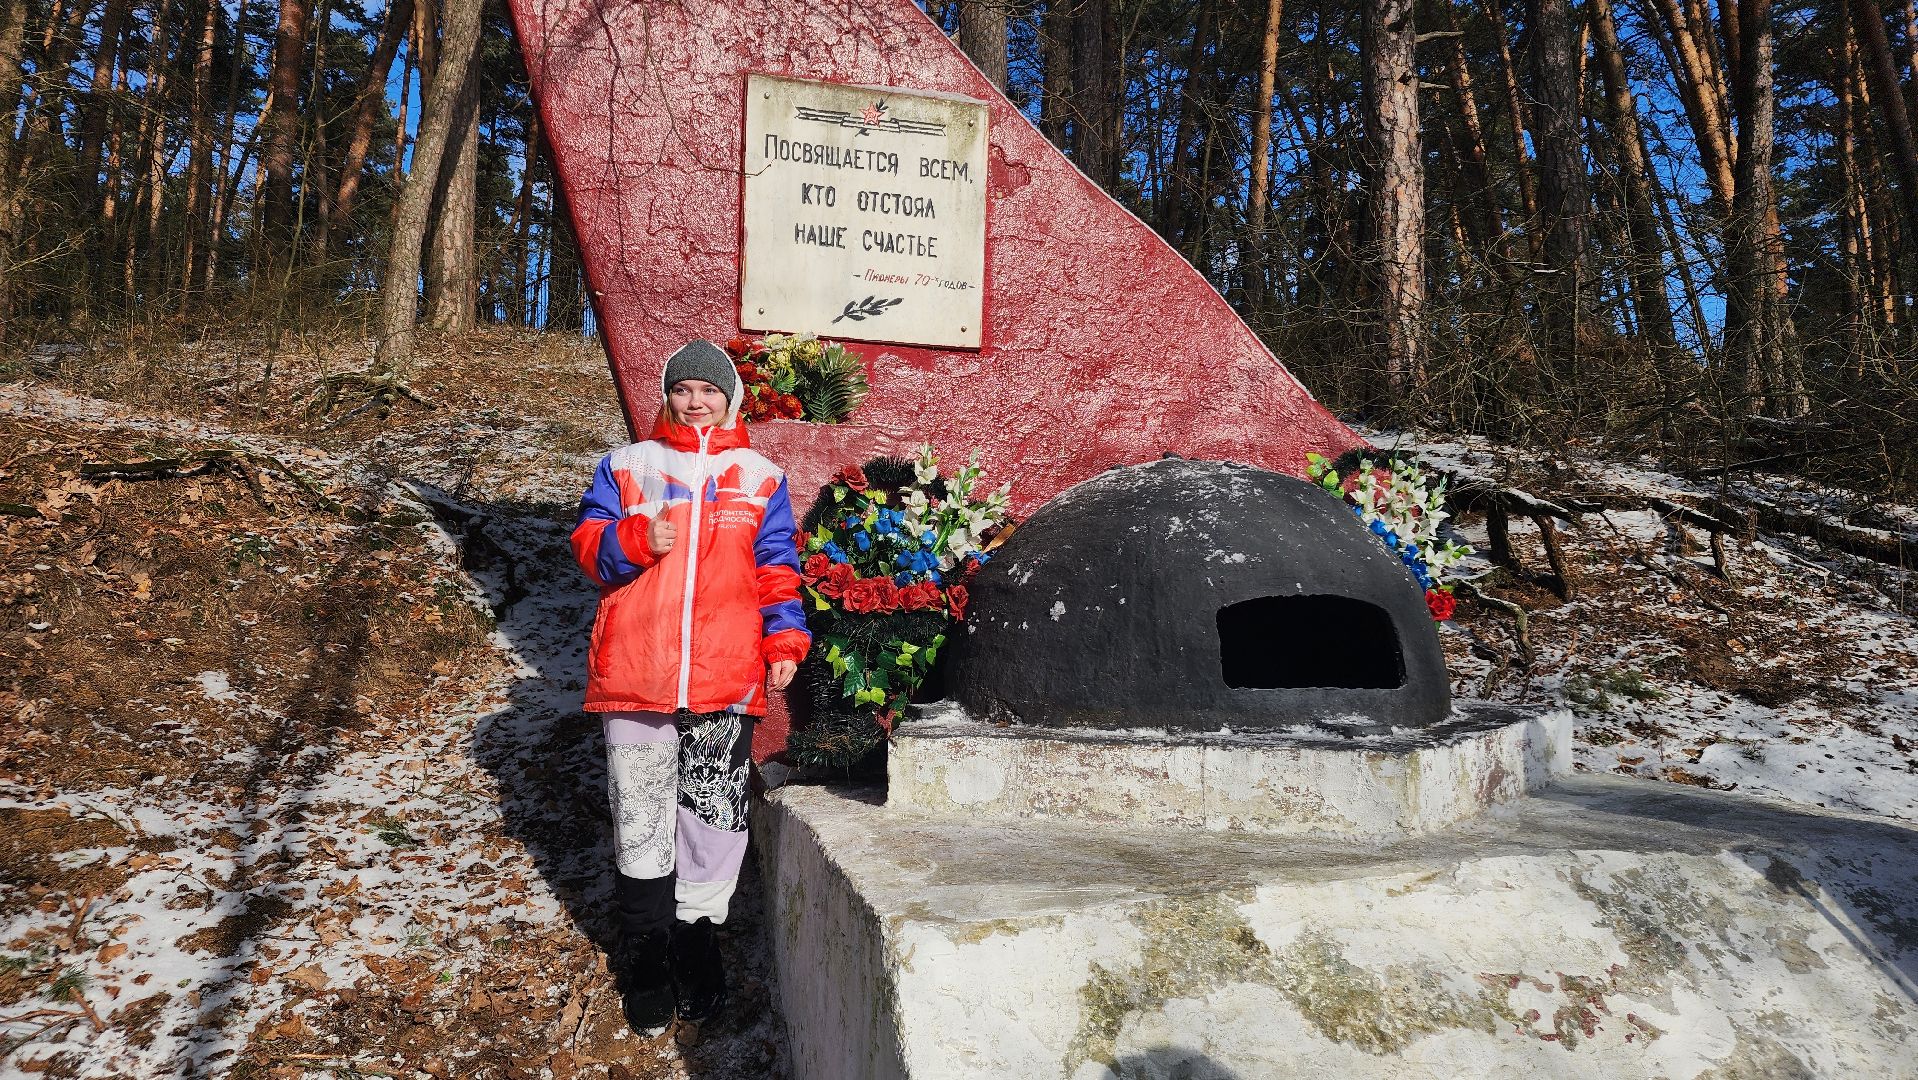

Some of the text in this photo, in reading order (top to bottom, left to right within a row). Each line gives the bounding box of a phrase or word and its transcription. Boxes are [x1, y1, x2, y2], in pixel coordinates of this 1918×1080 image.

[764, 133, 973, 184] ПОСВЯЩАЕТСЯ ВСЕМ,
[801, 182, 936, 219] КТО ОТСТОЯЛ
[794, 222, 938, 258] НАШЕ СЧАСТЬЕ
